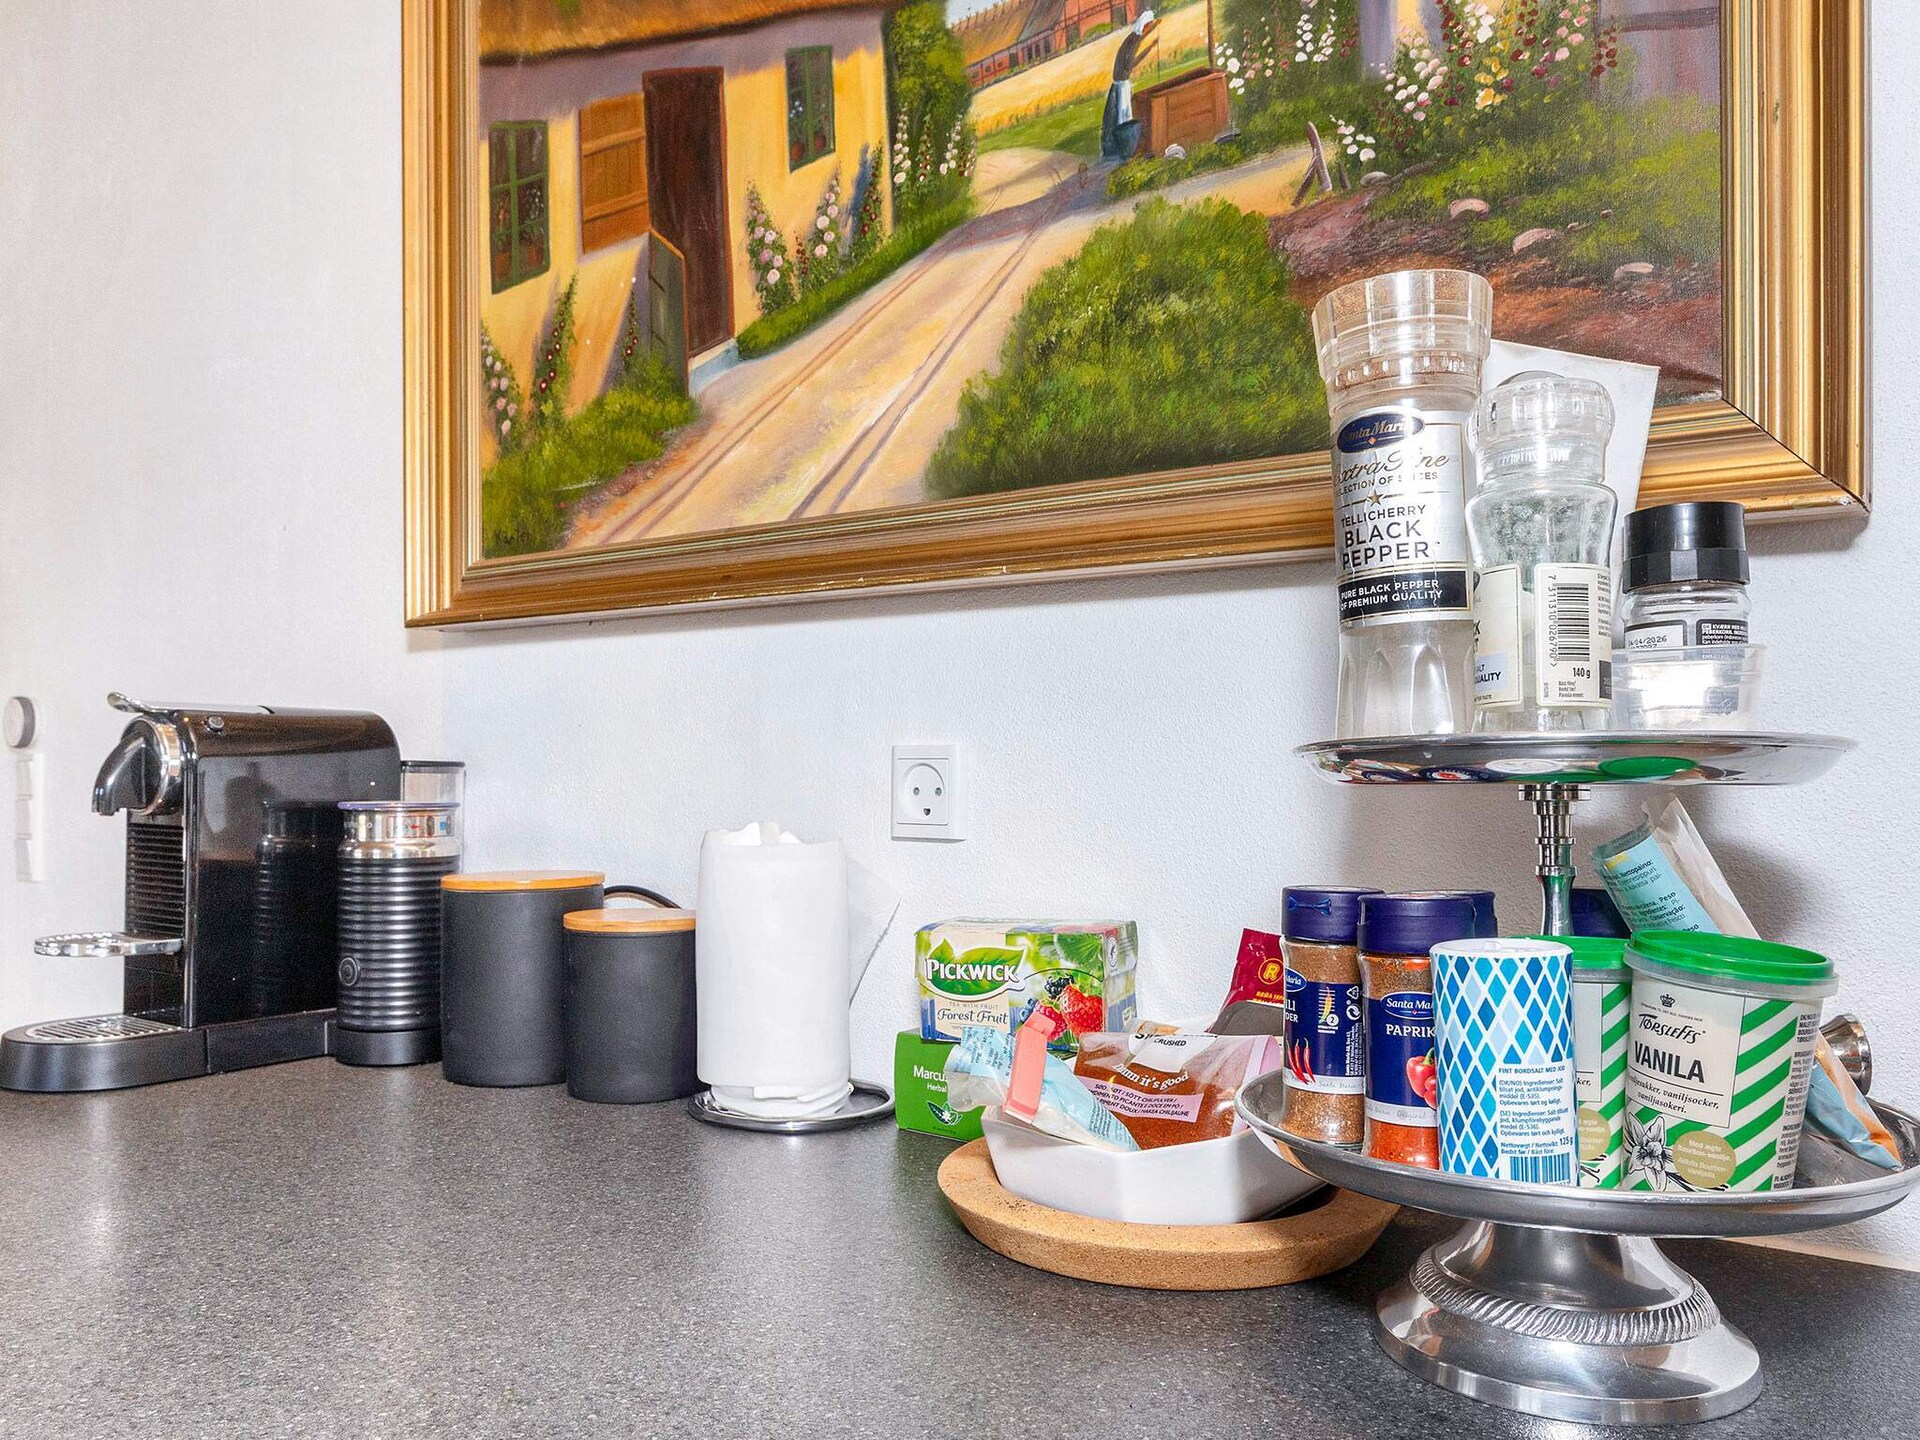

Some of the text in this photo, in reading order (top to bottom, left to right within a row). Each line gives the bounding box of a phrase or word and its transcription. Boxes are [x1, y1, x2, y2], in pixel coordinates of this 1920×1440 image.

[1379, 476, 1393, 486] OF
[1341, 504, 1426, 528] TELLICHERRY
[1344, 519, 1421, 549] BLACK
[1342, 541, 1429, 570] PEPPER
[1341, 579, 1439, 599] PURE BLACK PEPPER
[1341, 589, 1443, 611] OF PREMIUM QUALITY
[1573, 667, 1591, 679] 140 g
[1658, 891, 1676, 902] Peso
[925, 958, 1020, 983] PICKWICK
[1386, 998, 1413, 1009] Santa
[937, 1008, 1008, 1024] Forest Fruit
[1385, 1024, 1436, 1038] PAPRIK
[1154, 1038, 1187, 1047] CRUSHED
[1634, 1040, 1705, 1084] VANILA
[913, 1065, 947, 1082] Marcu
[1160, 1071, 1189, 1091] good
[927, 1083, 947, 1092] Herbal
[1663, 1089, 1719, 1109] vaniljsocker,
[1560, 1136, 1569, 1146] 125
